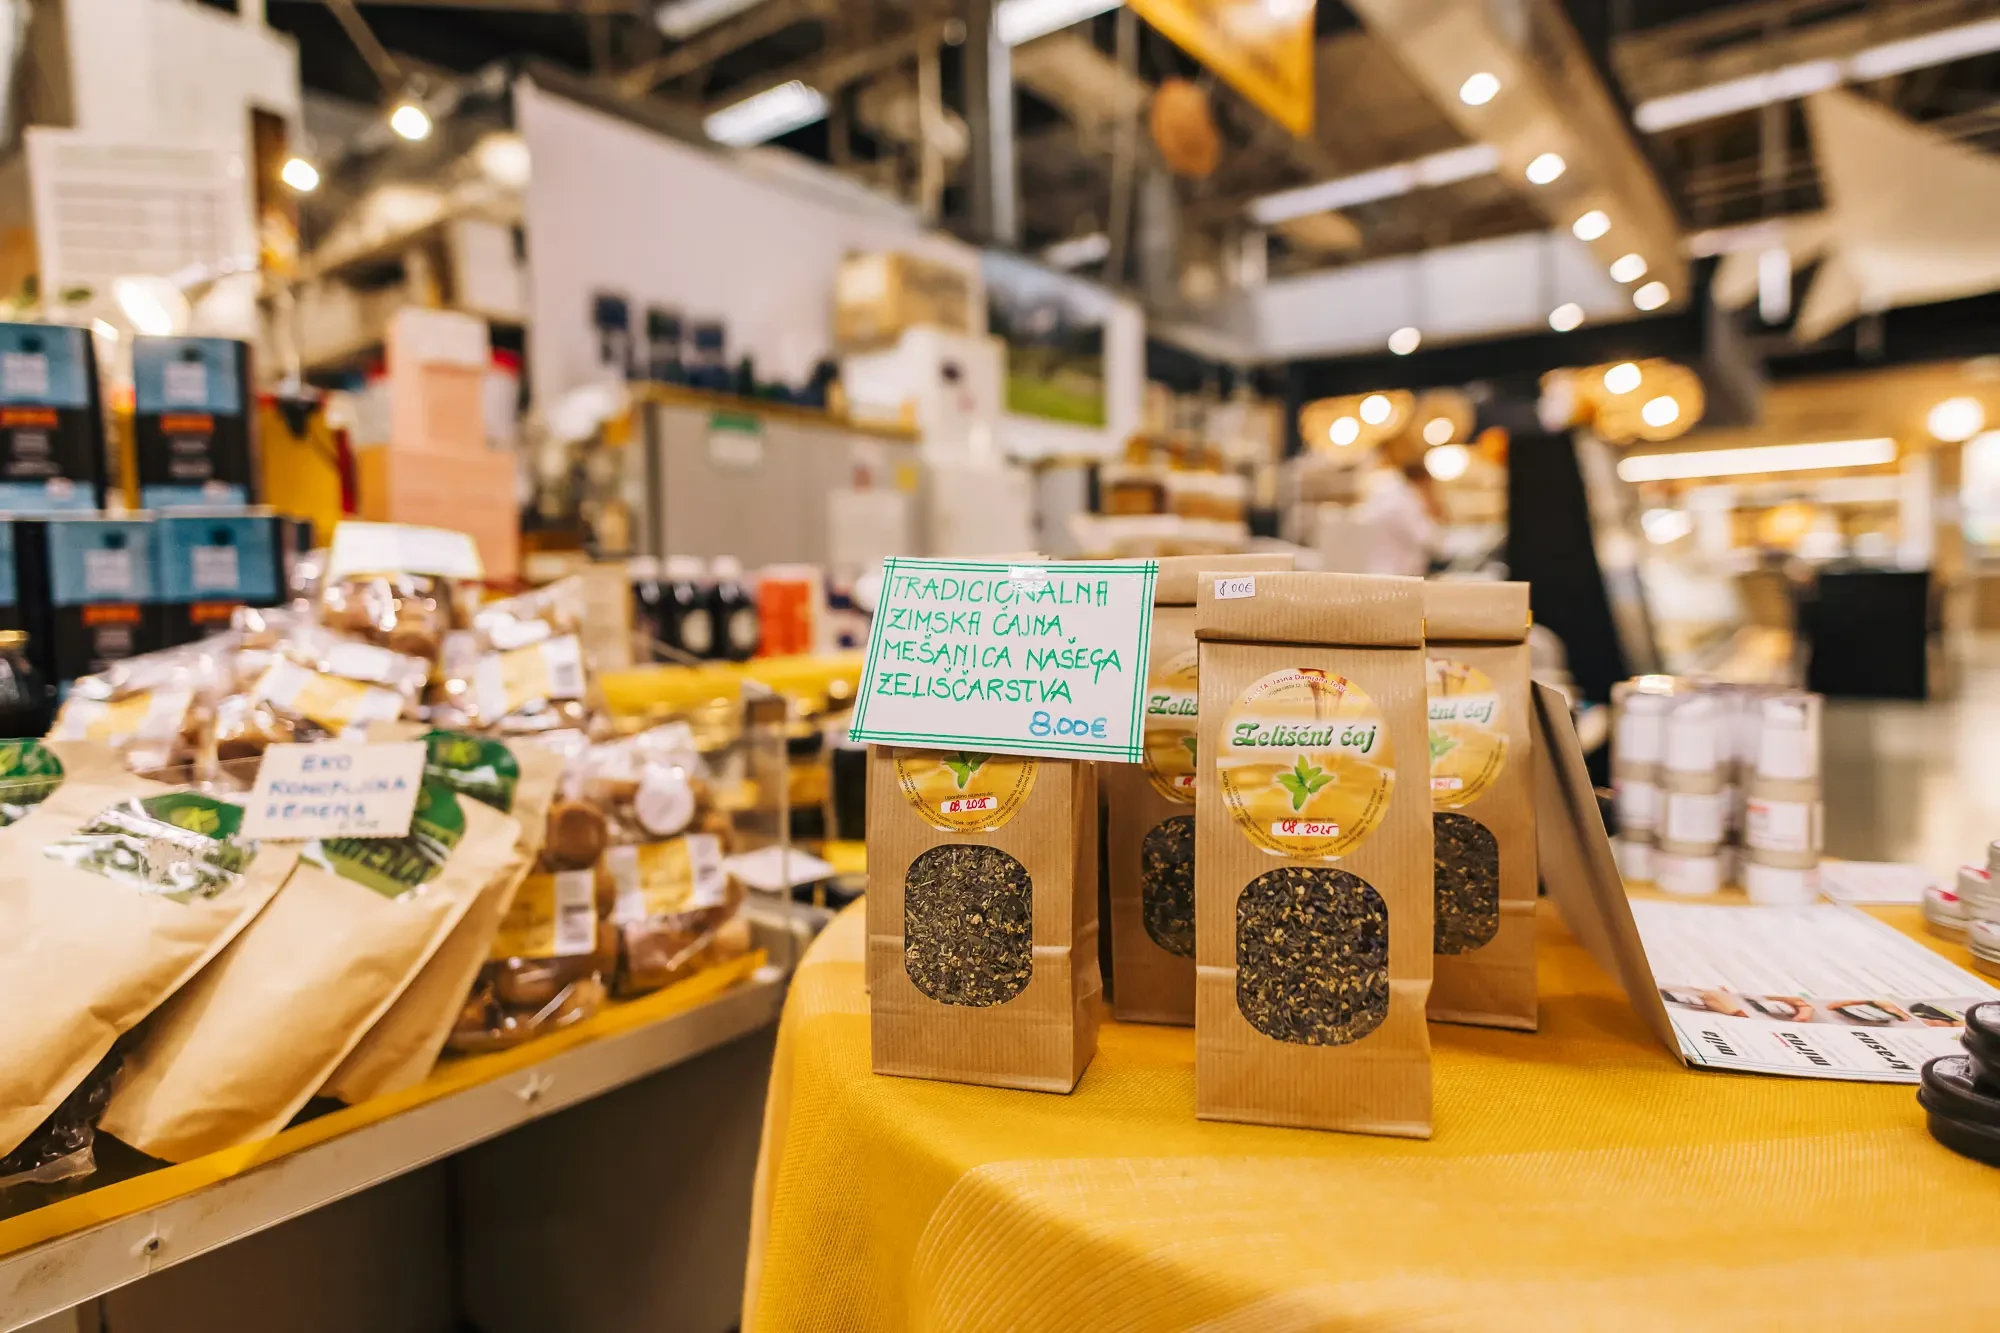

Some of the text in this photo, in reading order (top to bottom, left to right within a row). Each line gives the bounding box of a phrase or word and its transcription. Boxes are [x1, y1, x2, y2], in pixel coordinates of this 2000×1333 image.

[893, 575, 1109, 607] TRADICIONALNA
[886, 605, 1063, 637] ZIMSKA ČAJNA
[882, 633, 1122, 685] MEŠANICA NAŠEGA
[876, 668, 1073, 704] ZELIŠČARSTVA
[1231, 722, 1377, 754] Zeliščni čaj
[301, 754, 351, 773] EKO
[265, 803, 366, 819] SEMENA
[1701, 1030, 1738, 1057] mila
[1780, 1031, 1833, 1067] mirna
[1850, 1030, 1916, 1071] krasna
